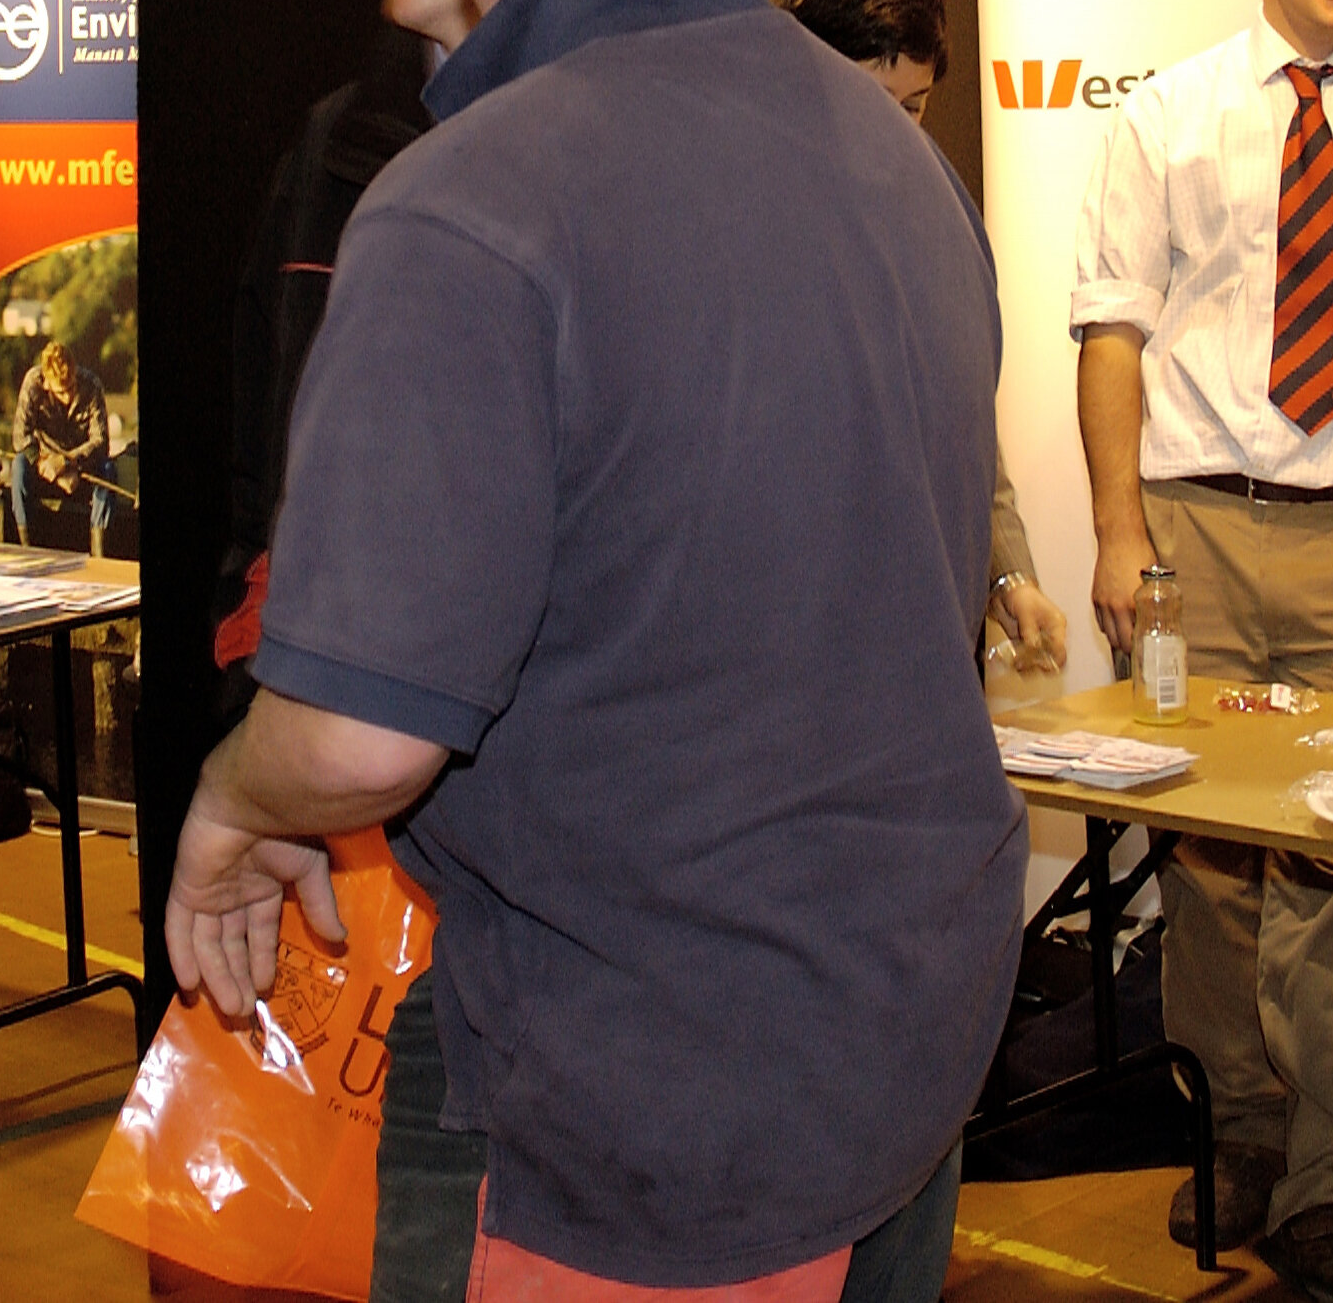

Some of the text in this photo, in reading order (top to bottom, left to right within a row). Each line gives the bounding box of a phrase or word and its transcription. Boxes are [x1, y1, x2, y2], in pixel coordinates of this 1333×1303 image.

[71, 4, 137, 40] Envi
[992, 59, 1155, 110] Wes
[339, 1037, 391, 1097] U
